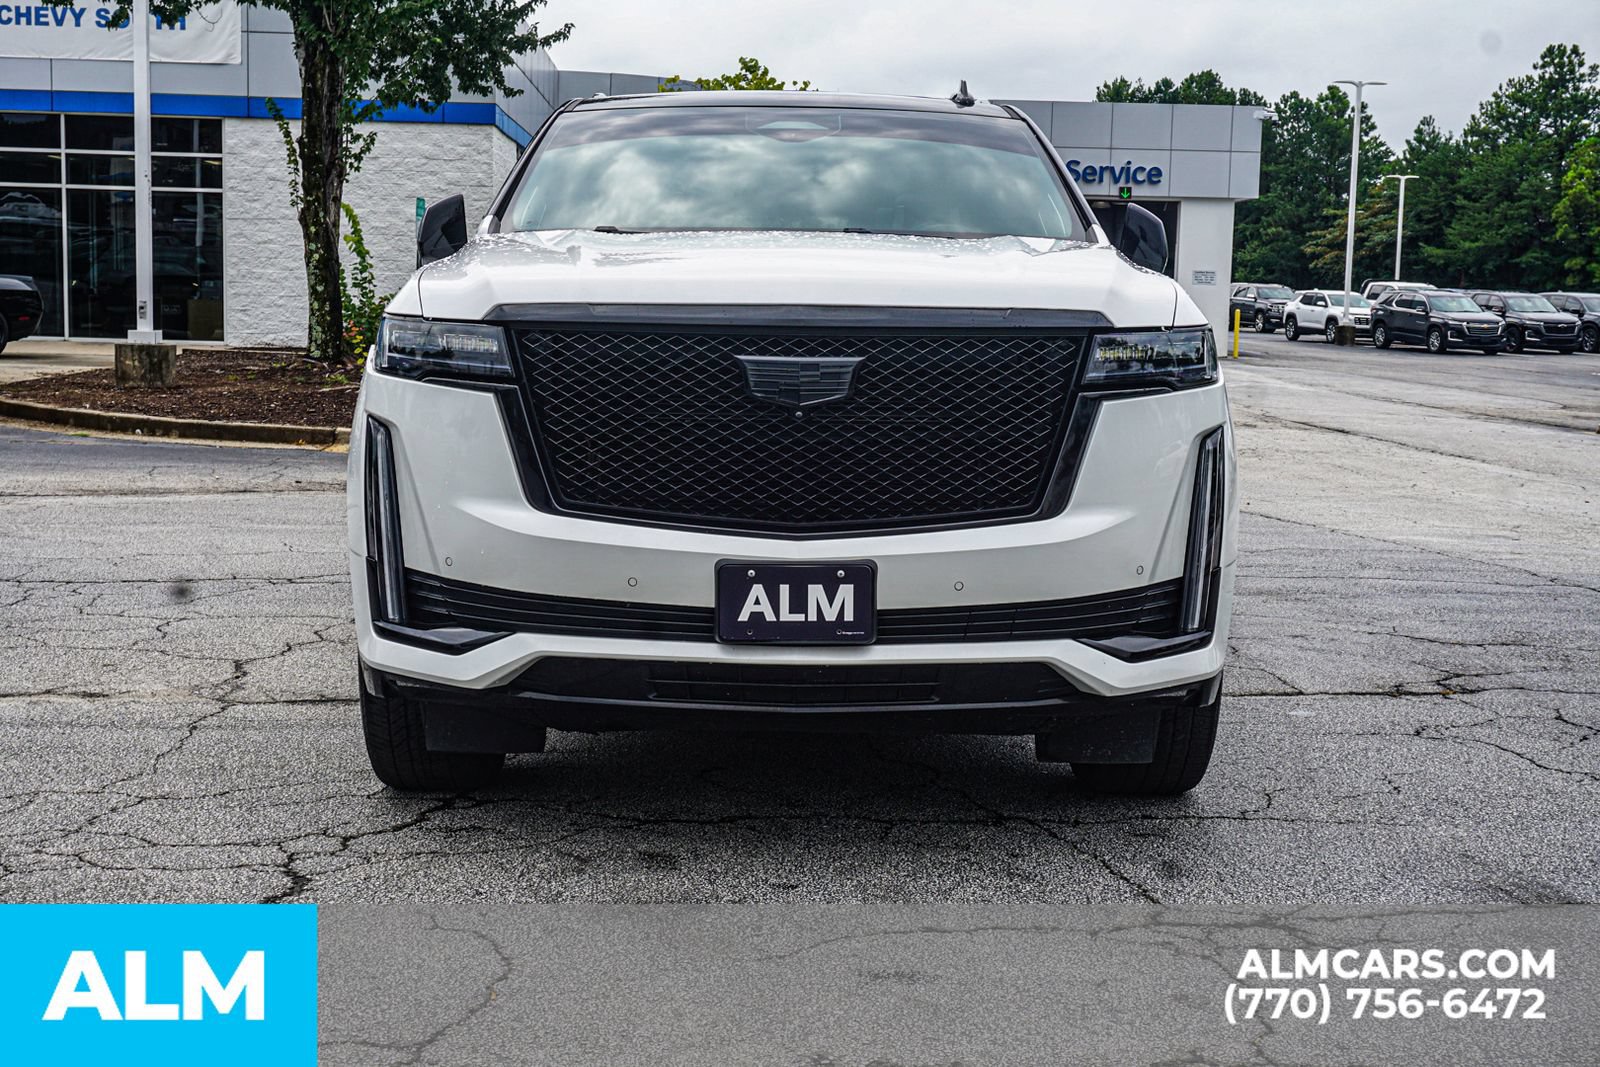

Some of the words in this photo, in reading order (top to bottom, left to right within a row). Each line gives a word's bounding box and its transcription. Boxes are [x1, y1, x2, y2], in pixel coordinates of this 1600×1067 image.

[0, 4, 87, 27] CHEVY
[1065, 159, 1163, 185] Service
[737, 583, 854, 622] ALM
